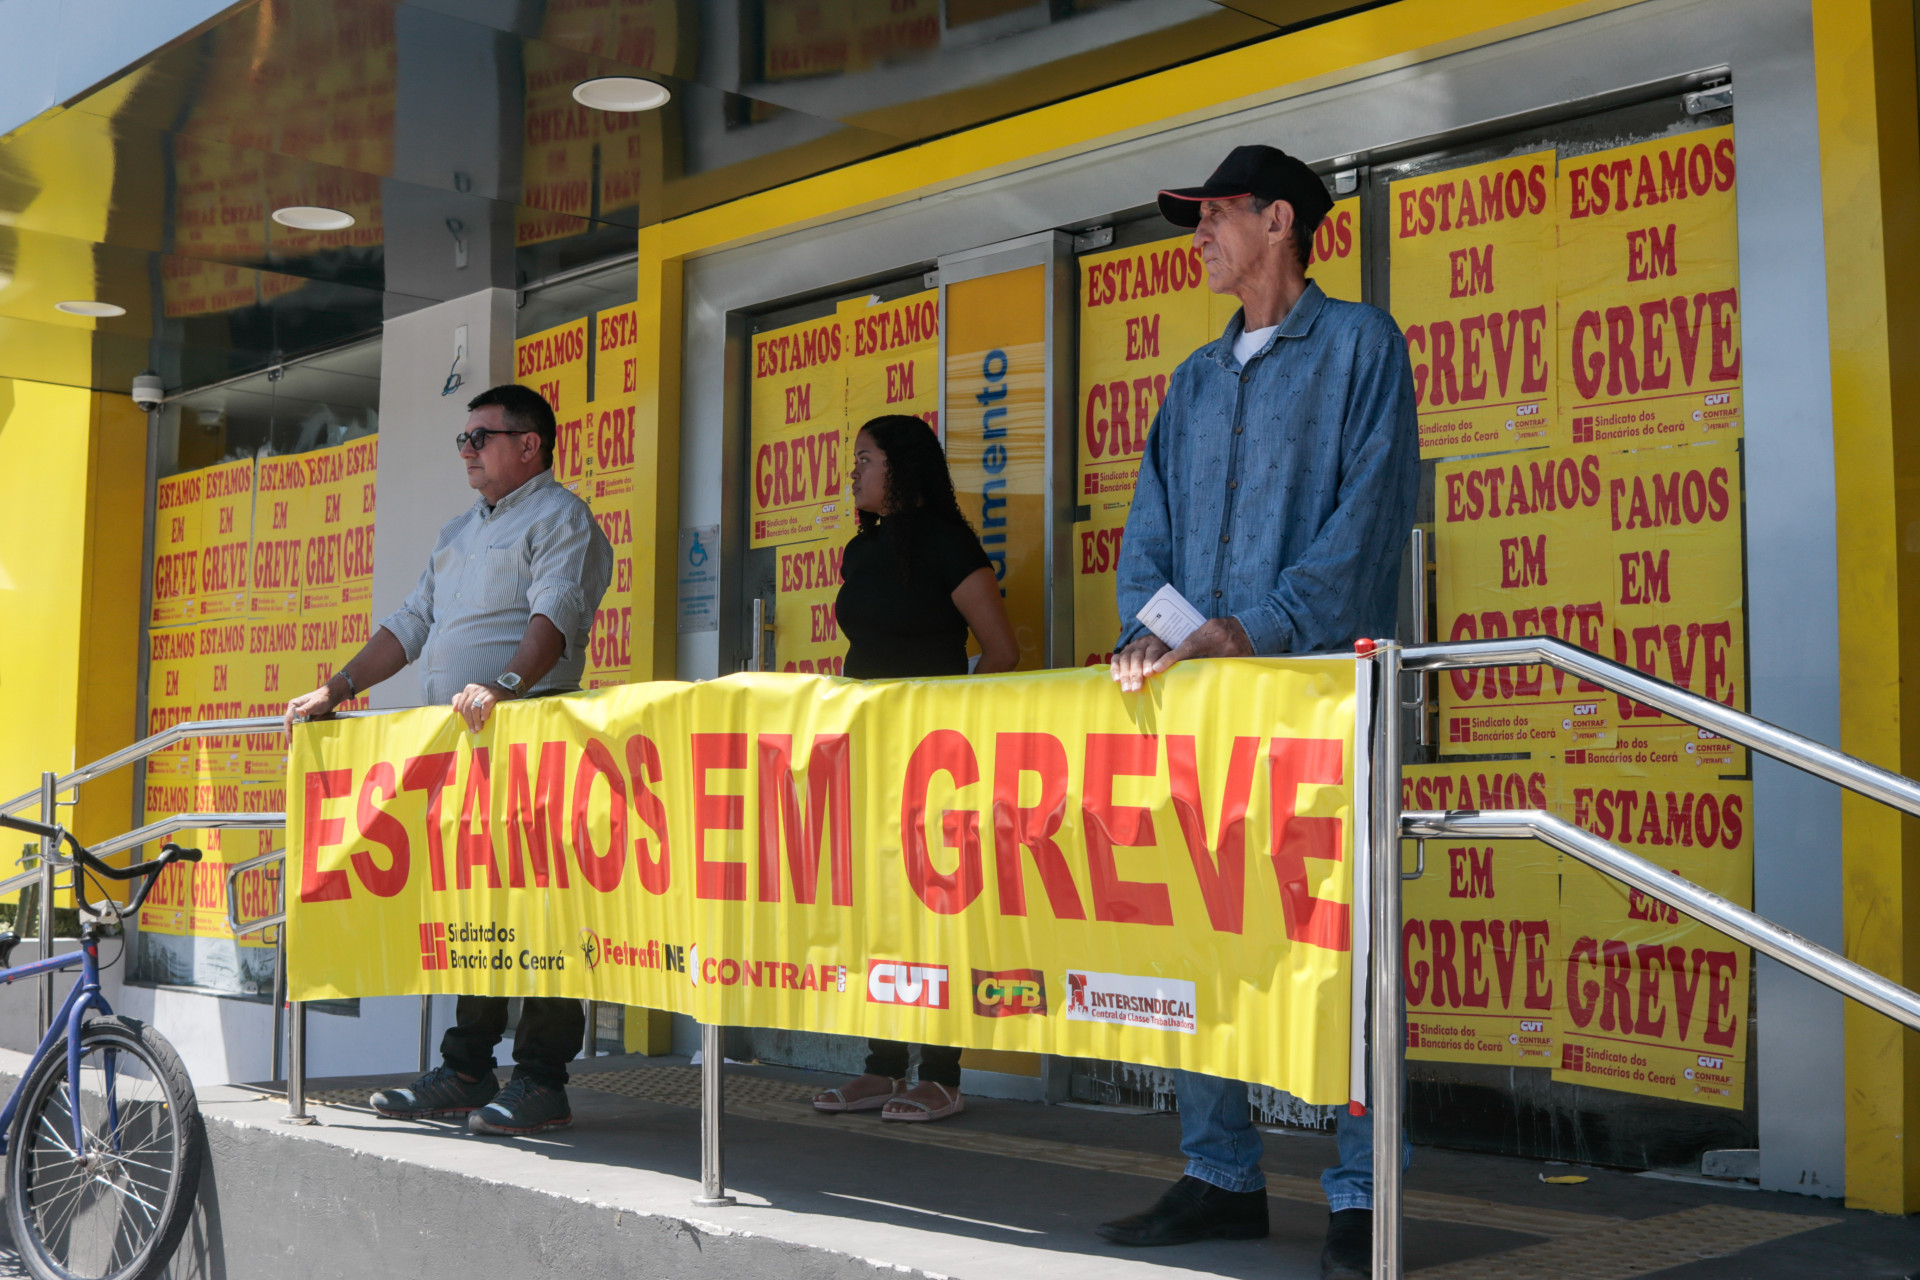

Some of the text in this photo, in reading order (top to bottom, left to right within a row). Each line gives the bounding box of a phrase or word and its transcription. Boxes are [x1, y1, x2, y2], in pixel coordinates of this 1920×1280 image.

[1568, 138, 1735, 220] ESTAMOS
[1399, 164, 1547, 239] ESTAMOS
[1626, 223, 1678, 282] EM
[1087, 245, 1202, 307] ESTAMOS
[1449, 244, 1494, 299] EM
[518, 327, 584, 378] ESTAMOS
[757, 323, 841, 378] ESTAMOS
[1125, 313, 1160, 361] EM
[1572, 287, 1741, 400] GREVE
[1404, 304, 1548, 409] GREVE
[886, 360, 914, 404] EM
[785, 383, 811, 424] EM
[1517, 404, 1538, 416] CUT
[1705, 393, 1730, 406] CUT
[1085, 373, 1175, 459] GRE
[1418, 420, 1473, 435] Sindicato dos
[1595, 410, 1656, 427] Sindicato dos
[1595, 420, 1685, 441] Bancários do Ceará
[1419, 429, 1499, 447] Bancários do Ceará
[346, 440, 378, 477] ESTA
[756, 430, 841, 509] GREVE
[205, 465, 251, 499] ESTAMOS
[1100, 471, 1129, 482] Sindicato
[1445, 454, 1600, 523] ESTAMOS
[158, 476, 201, 510] ESTAMOS
[325, 493, 341, 523] EM
[171, 516, 185, 543] EM
[219, 506, 234, 534] EM
[273, 501, 288, 529] EM
[155, 550, 198, 600] GREVE
[202, 541, 247, 592] GREVE
[254, 539, 301, 589] GREVE
[1500, 534, 1547, 589] EM
[1619, 549, 1671, 605] EM
[811, 602, 837, 643] EM
[152, 630, 195, 661] ESTAMOS
[200, 624, 245, 655] ESTAMOS
[250, 623, 297, 654] ESTAMOS
[1449, 600, 1605, 701] GREVE
[166, 671, 179, 696] EM
[213, 665, 228, 692] EM
[265, 664, 280, 692] EM
[1472, 715, 1529, 728] Sindicato dos
[1574, 704, 1597, 715] CUT
[1472, 728, 1556, 742] Bancários do Ceará
[1632, 738, 1648, 749] dos
[1588, 751, 1678, 763] Bancários do Ceará
[147, 786, 189, 812] ESTAMOS
[193, 785, 239, 813] ESTAMOS
[1573, 788, 1743, 850] ESTAMOS
[300, 729, 1351, 952] ESTAMOS EM GREVE
[1448, 847, 1495, 899] EM
[491, 949, 513, 970] do
[519, 950, 565, 970] Ceará
[702, 957, 837, 992] CONTRAF
[1402, 918, 1553, 1011] GREVE
[868, 963, 948, 1006] CUT
[977, 977, 1041, 1007] CTB
[1566, 935, 1738, 1049] GREVE
[1091, 991, 1194, 1019] INTERSINDICAL
[1091, 1008, 1195, 1030] Central da Classe Trabalhadora
[1420, 1024, 1476, 1037] Sindicato dos
[1520, 1021, 1543, 1032] CUT
[1421, 1038, 1503, 1052] Bancários do Ceará
[1585, 1047, 1647, 1067] Sindicato dos
[1585, 1061, 1676, 1086] Bancários do Ceará
[1698, 1056, 1723, 1069] CUT
